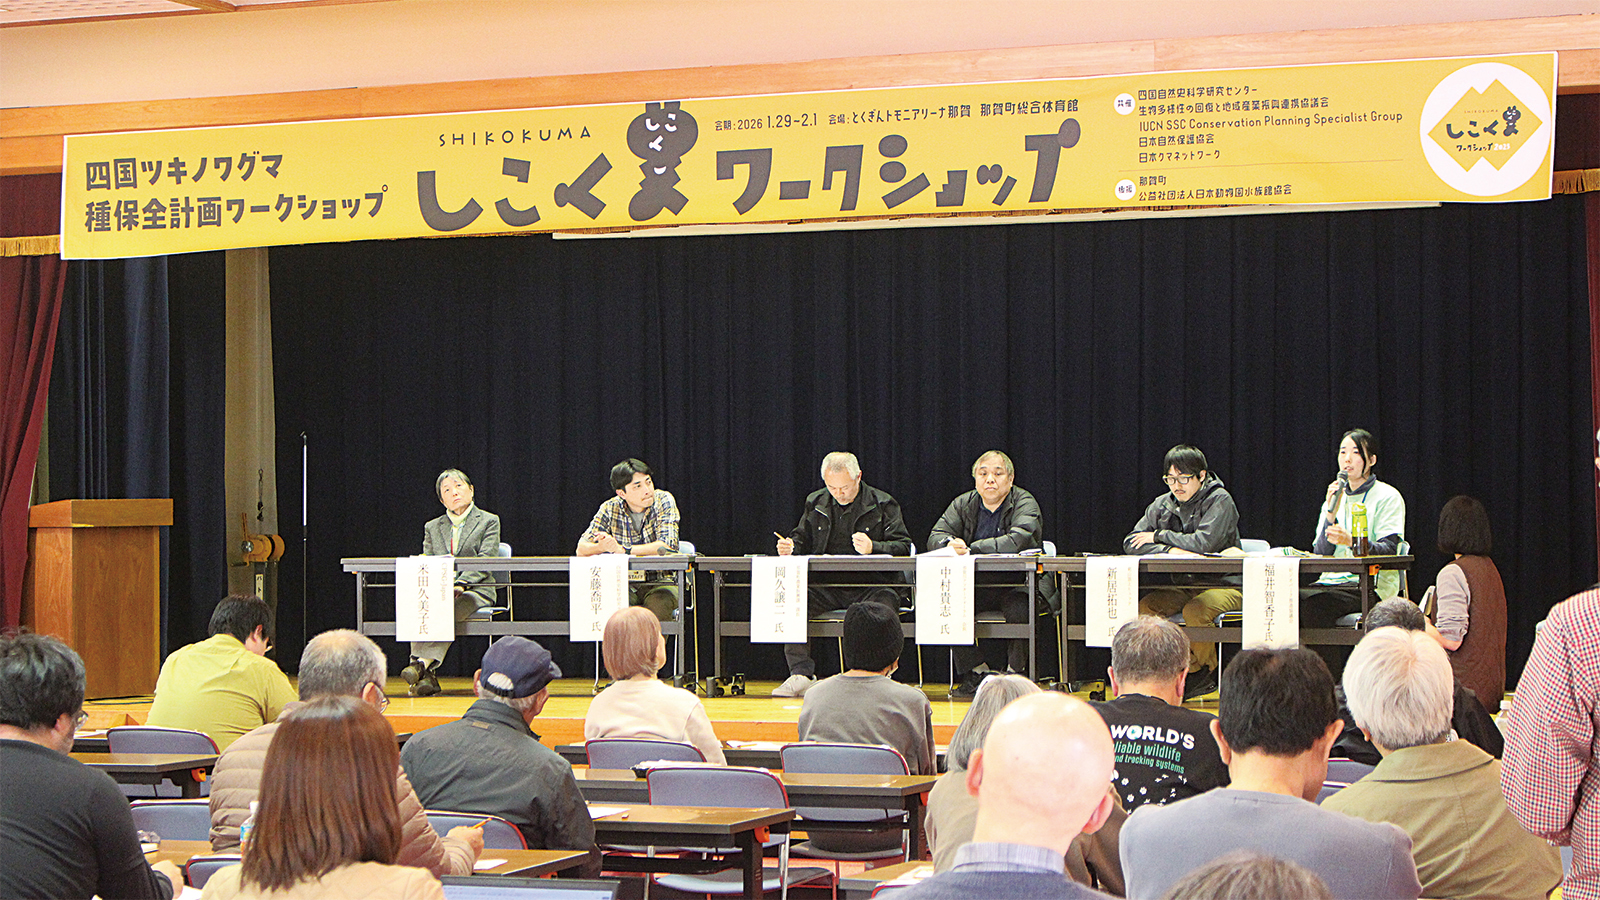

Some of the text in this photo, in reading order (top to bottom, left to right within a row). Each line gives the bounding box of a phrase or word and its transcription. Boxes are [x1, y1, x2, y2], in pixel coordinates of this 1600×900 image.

[1138, 85, 1258, 101] 四国自然史科学研究センター
[980, 98, 1079, 117] 那賀町総合体育館
[1139, 110, 1403, 132] IUCN SSC Conservation Planning Specialist Group
[439, 126, 592, 147] SHIKOKUMA
[1139, 133, 1215, 148] 日本自然保護協会
[716, 118, 1081, 216] ワークショップ
[1139, 150, 1221, 163] 日本クマネットワーク
[85, 151, 283, 191] 四国ツキノワグマ
[1139, 175, 1167, 186] 那賀町
[1139, 184, 1292, 202] 公益社団法人日本動物園水族館協会
[84, 184, 389, 232] 種保全計画ワークショップ
[1110, 724, 1195, 750] WORLD'S
[1113, 741, 1182, 762] liable wildlife
[1125, 754, 1155, 768] tracking
[1155, 759, 1185, 775] systems
